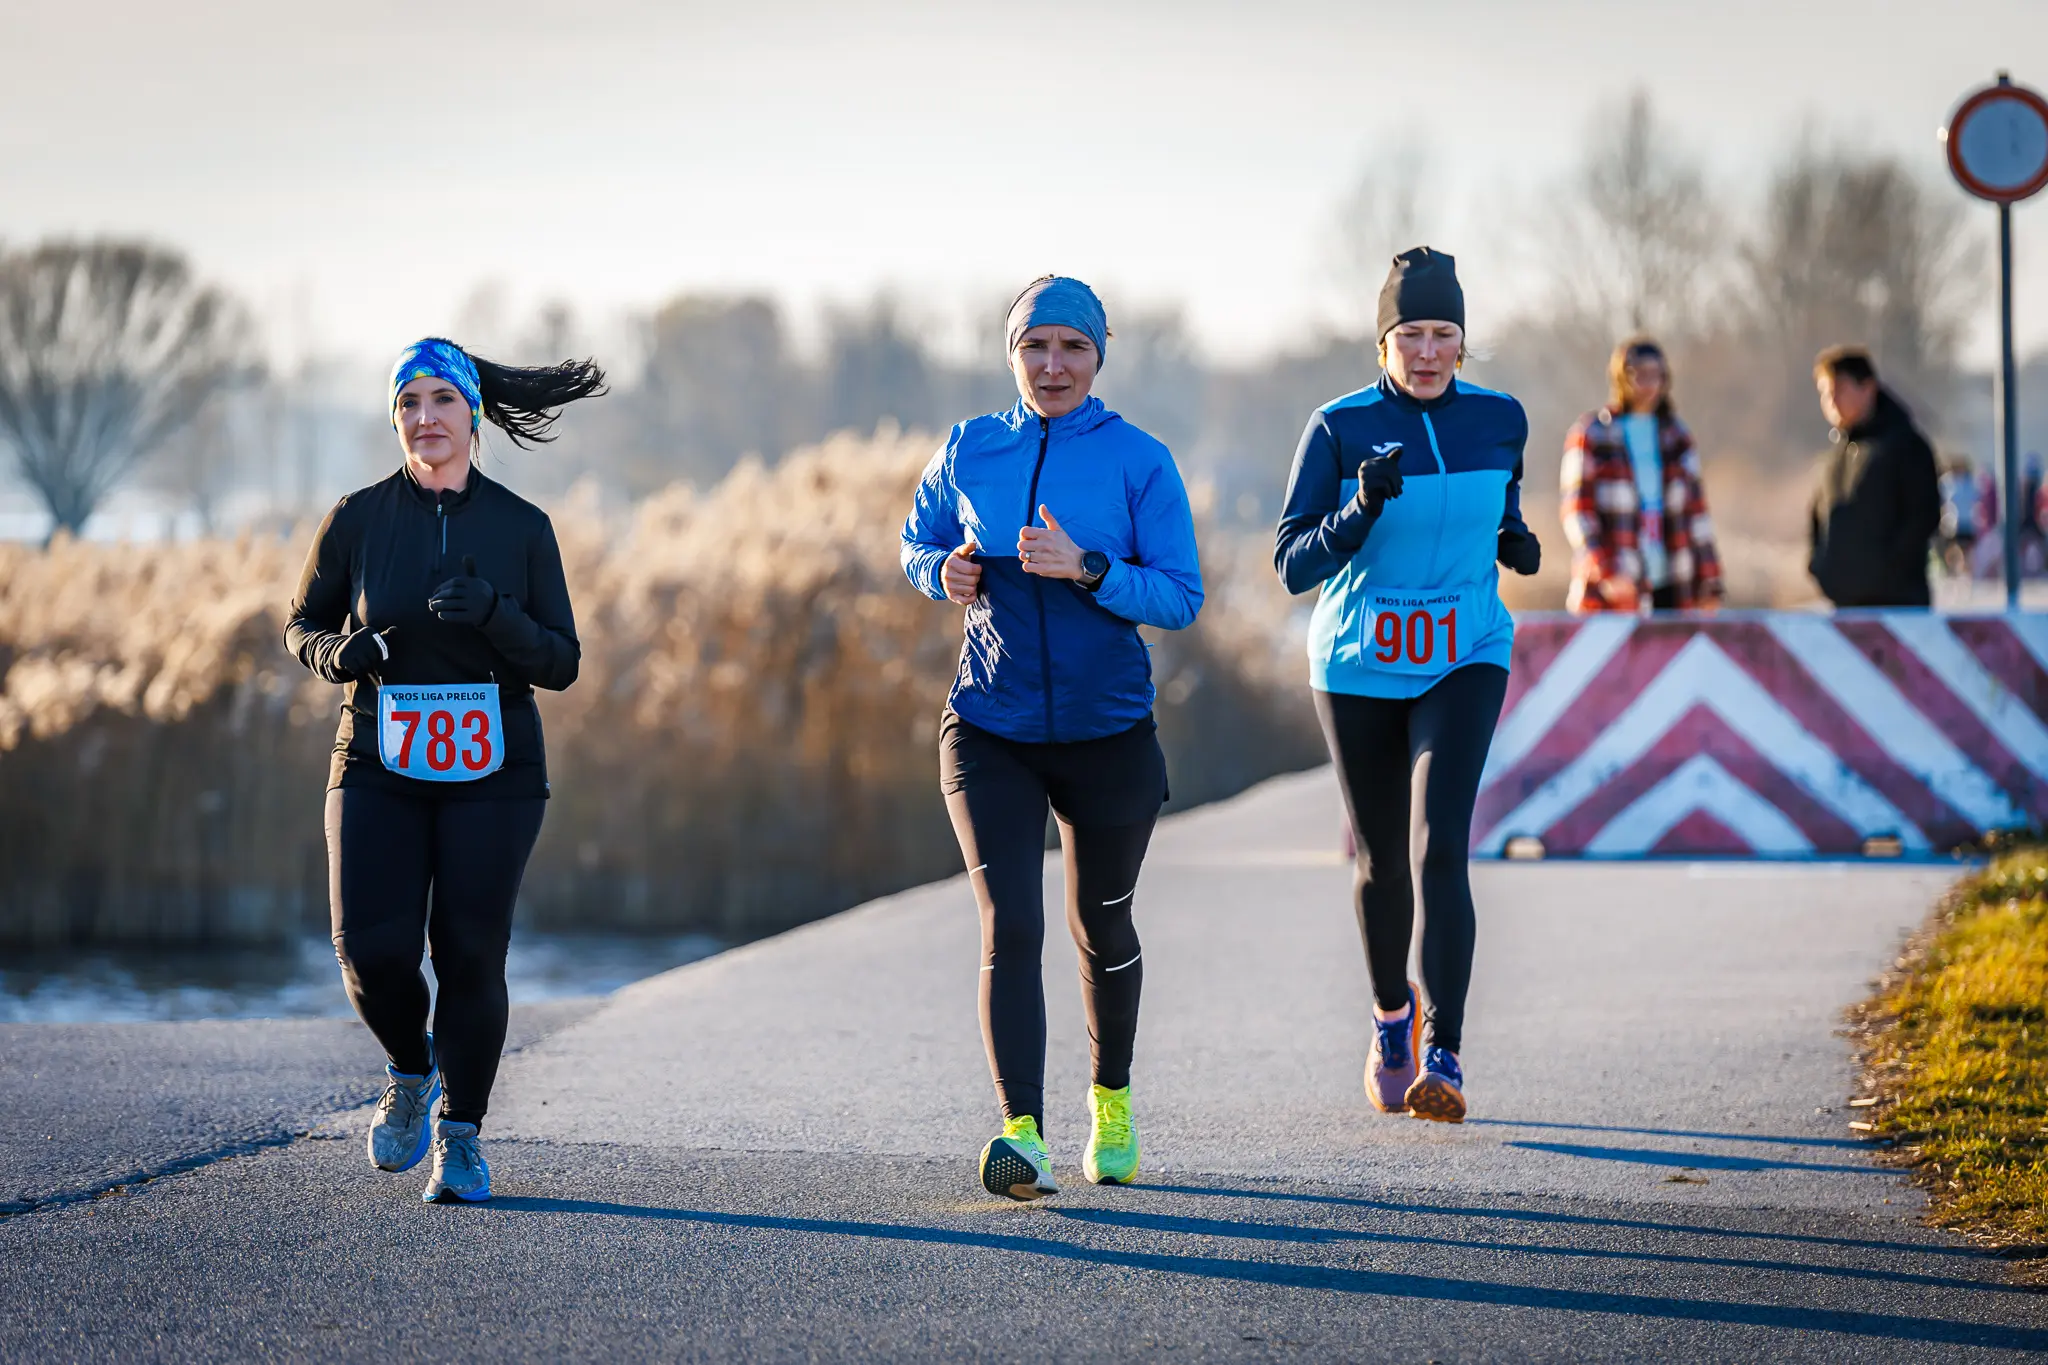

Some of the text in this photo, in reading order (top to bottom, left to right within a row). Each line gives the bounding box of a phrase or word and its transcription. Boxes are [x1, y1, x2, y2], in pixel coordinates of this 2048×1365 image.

[1375, 596, 1400, 607] KROS
[1402, 598, 1424, 607] LIGA
[1375, 607, 1457, 665] 901
[391, 692, 486, 701] KROS LIGA PRELOG
[391, 710, 492, 771] 783
